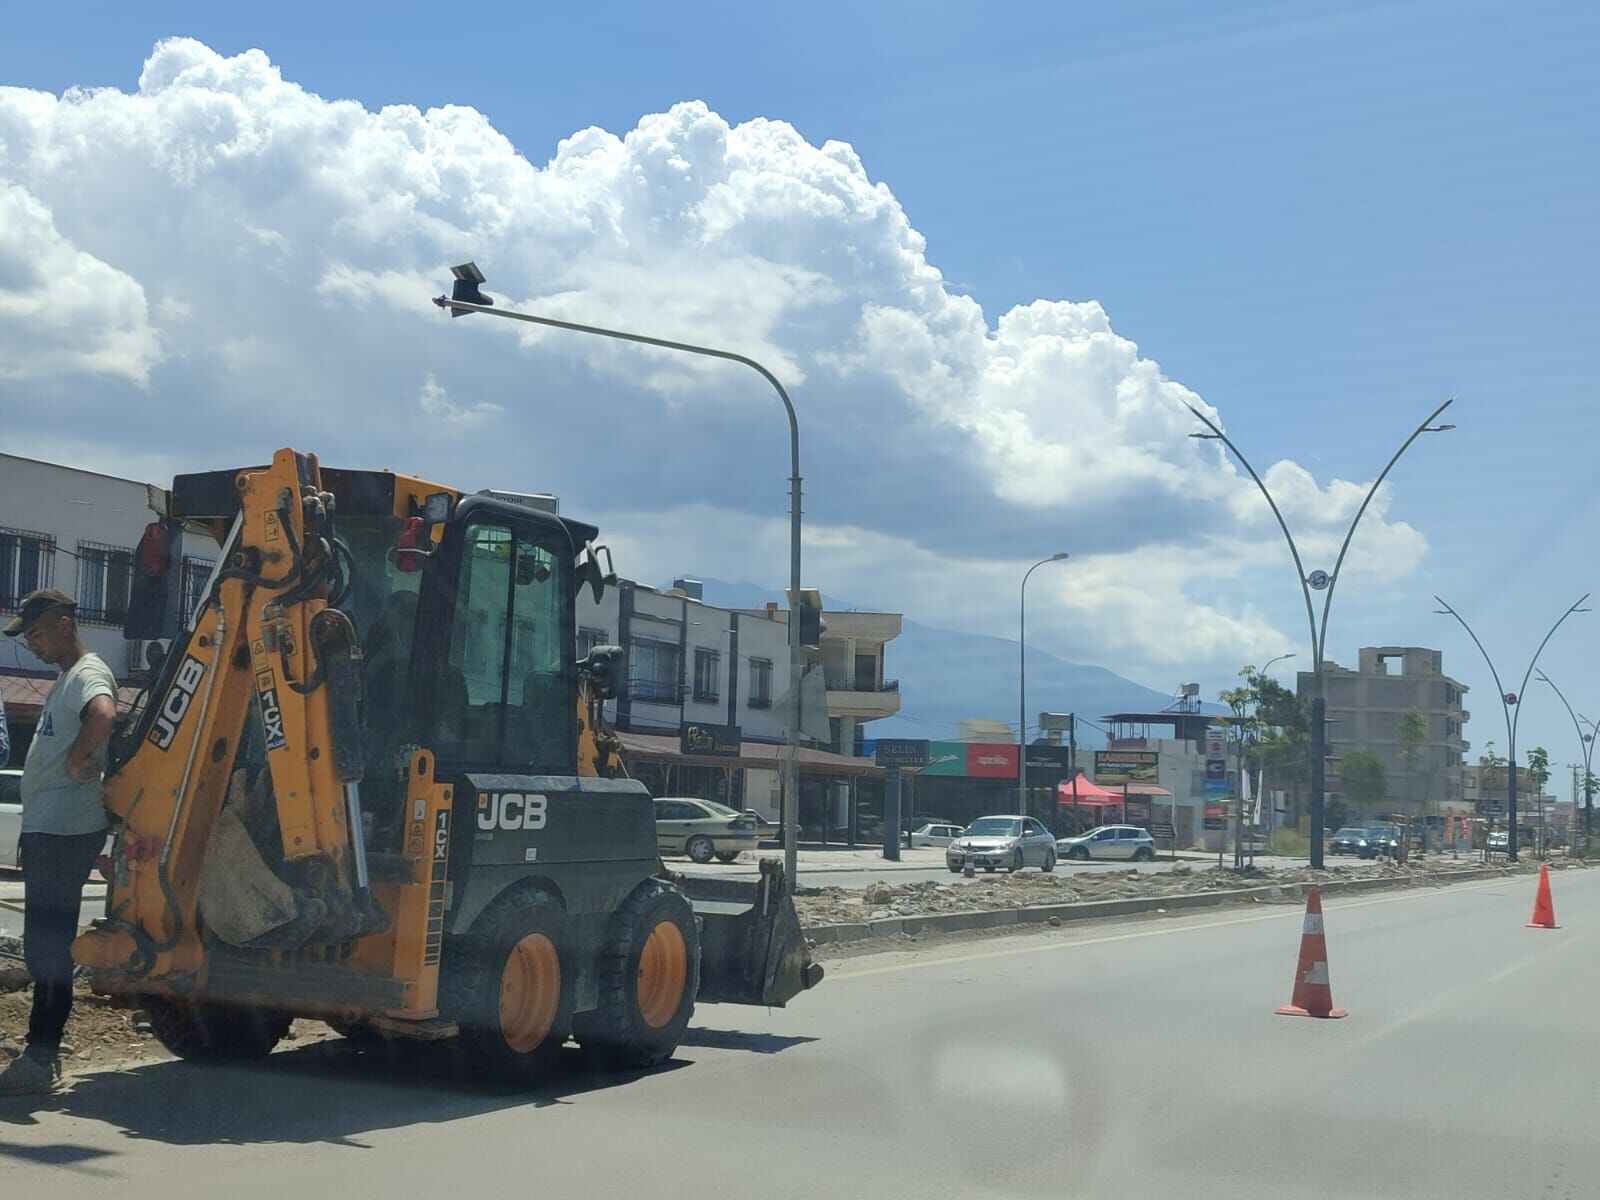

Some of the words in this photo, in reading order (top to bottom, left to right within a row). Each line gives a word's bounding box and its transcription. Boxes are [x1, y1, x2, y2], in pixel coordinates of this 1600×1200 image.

[156, 658, 204, 749] JCB
[262, 690, 284, 741] 1CX
[434, 812, 448, 859] 1CX
[477, 793, 548, 830] JCB
